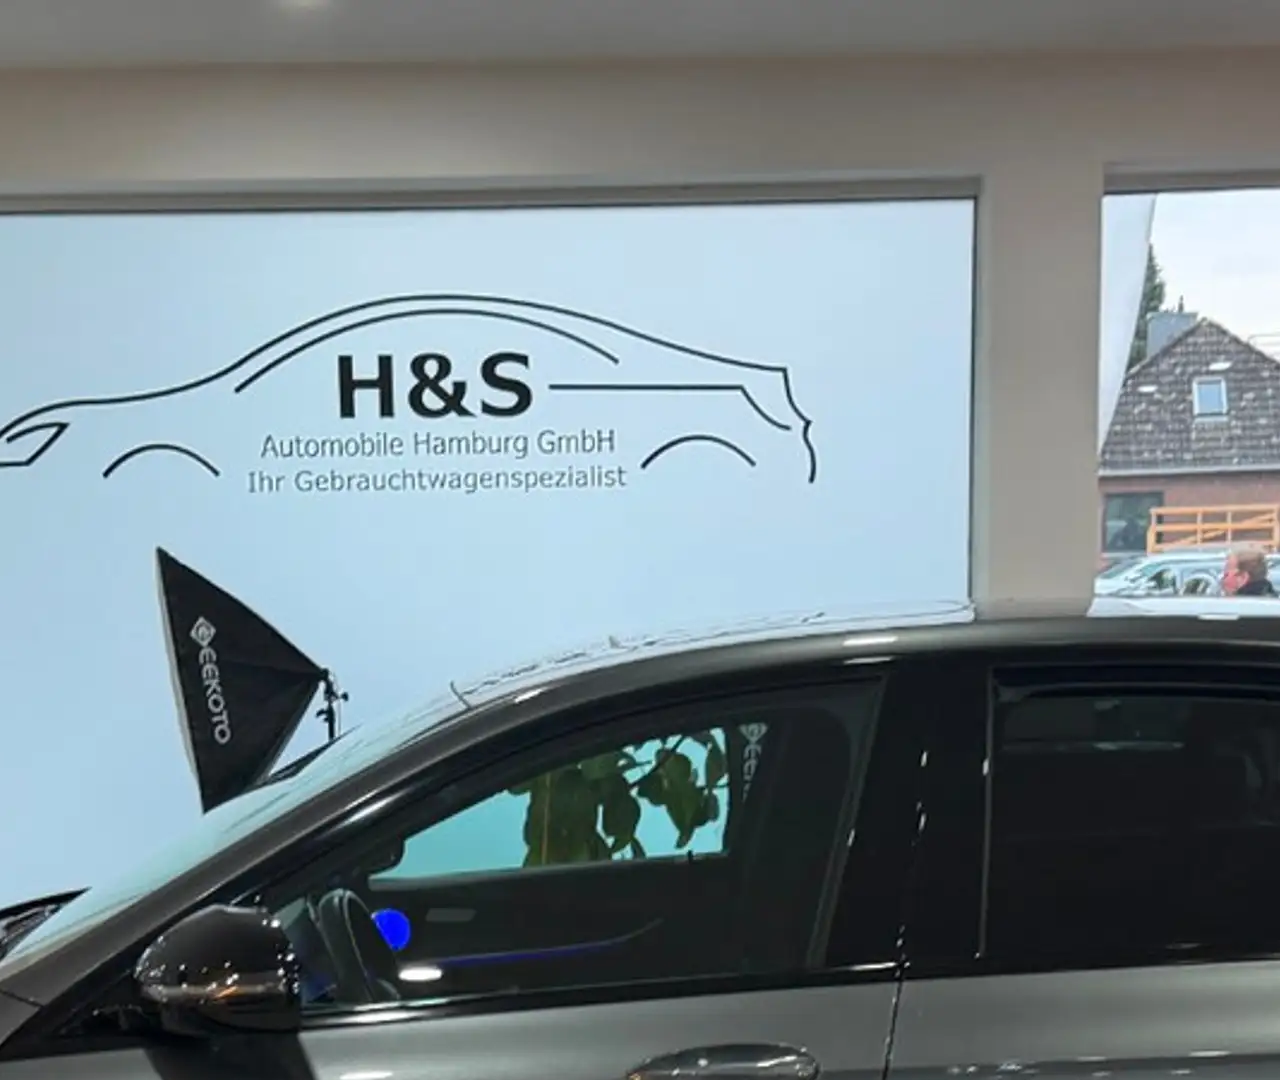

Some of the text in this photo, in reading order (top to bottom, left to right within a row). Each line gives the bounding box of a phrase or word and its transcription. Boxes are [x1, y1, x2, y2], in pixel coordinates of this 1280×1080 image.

[338, 352, 532, 418] H&S
[261, 429, 615, 459] Automobile Hamburg GmbH
[248, 466, 628, 494] Ihr Gebrauchtwagenspezialist
